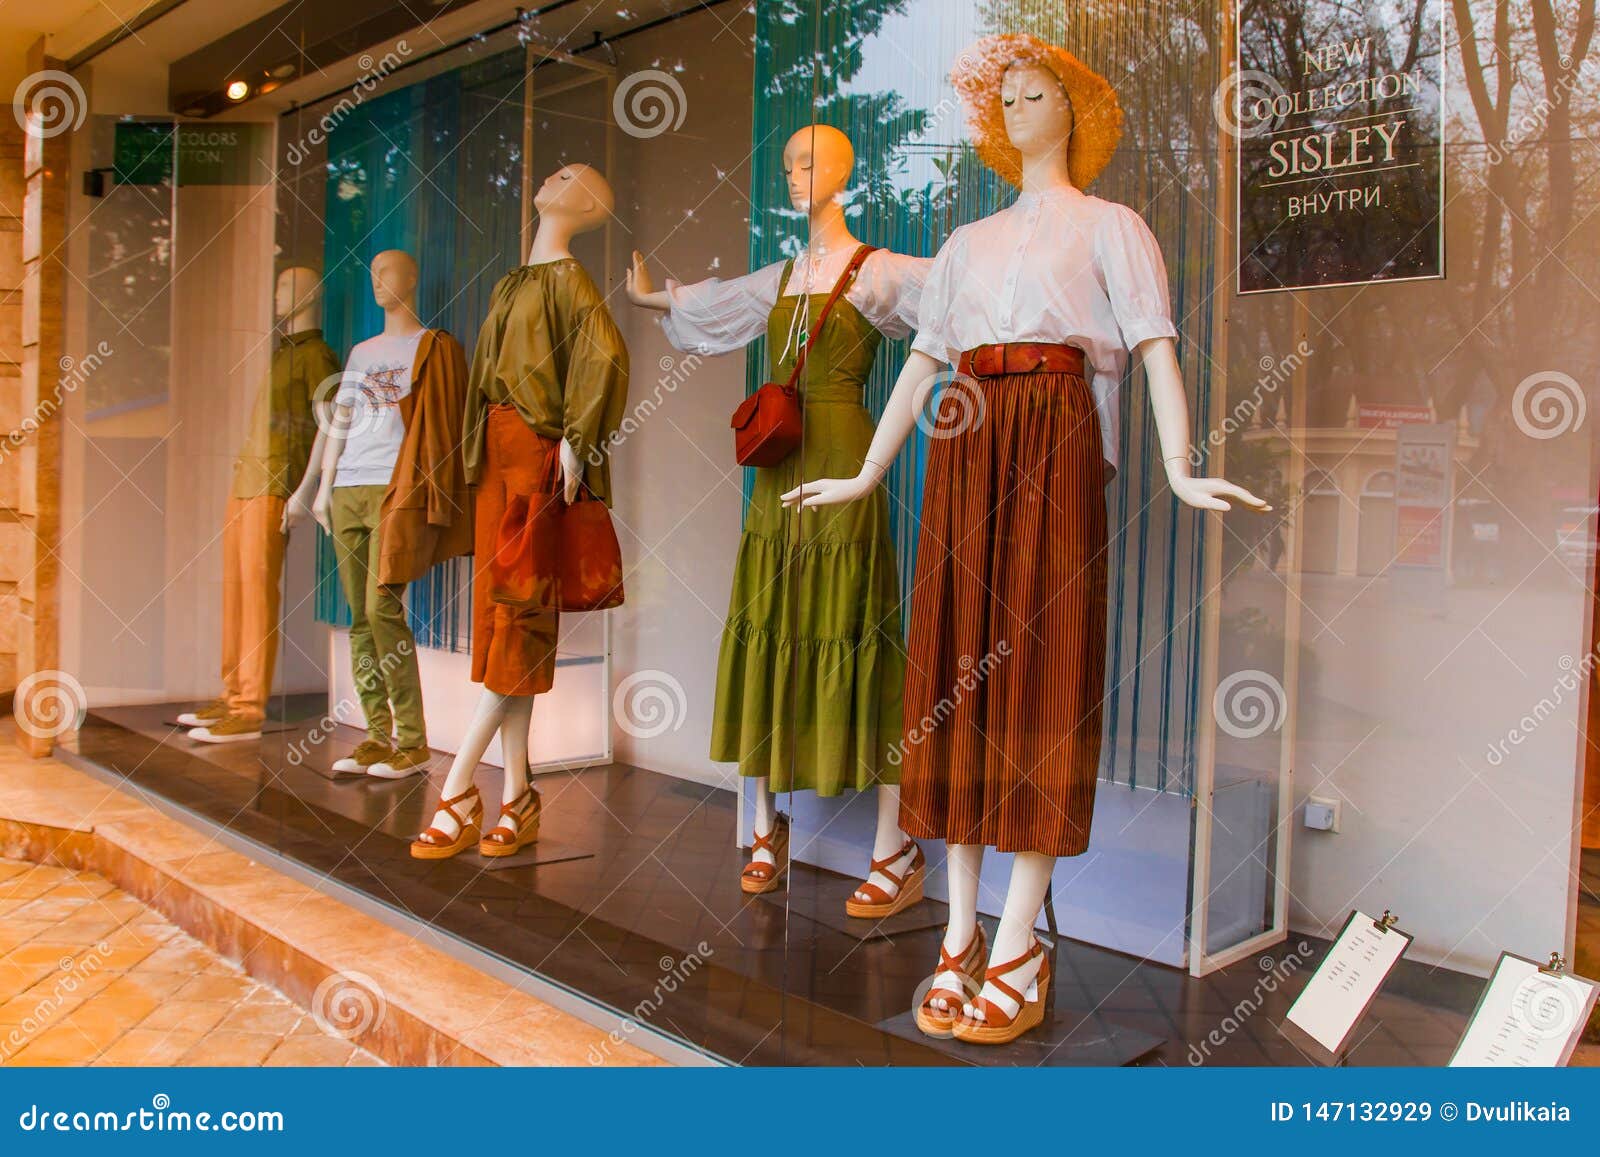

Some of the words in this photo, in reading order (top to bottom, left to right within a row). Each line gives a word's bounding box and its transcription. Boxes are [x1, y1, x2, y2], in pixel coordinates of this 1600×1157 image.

[1303, 37, 1372, 76] NEW
[1253, 70, 1423, 121] COLLECTION
[178, 132, 238, 147] COLORS
[1267, 120, 1407, 178] SISLEY
[1287, 185, 1381, 218] ВНУТРИ
